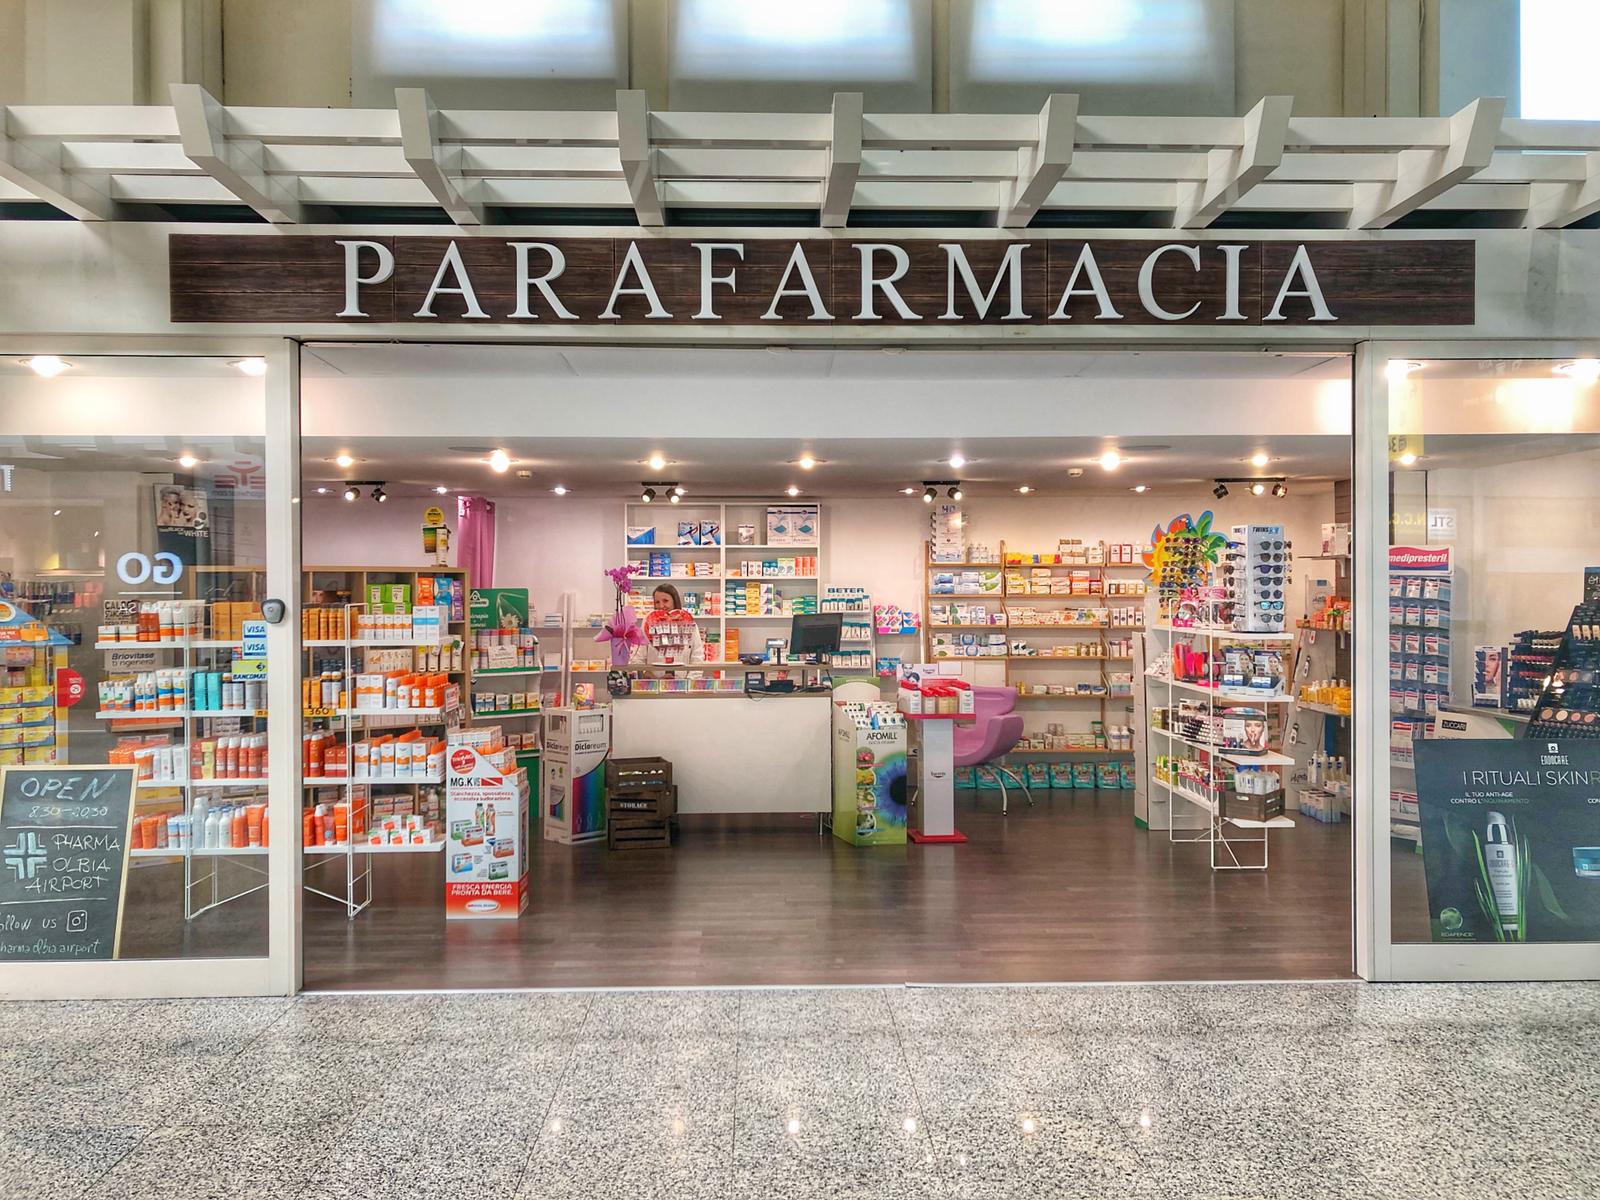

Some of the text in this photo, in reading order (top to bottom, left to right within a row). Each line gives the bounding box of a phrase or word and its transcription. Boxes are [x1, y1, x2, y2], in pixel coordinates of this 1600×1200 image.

[334, 240, 1339, 322] PARAFARMACIA
[184, 530, 209, 538] WHITE
[247, 625, 266, 633] VISA
[247, 643, 266, 651] VISA
[866, 731, 897, 741] AFOMILL
[574, 742, 606, 751] Dicloreum
[1472, 770, 1541, 786] RITUALI
[20, 773, 117, 801] OPEN
[51, 833, 121, 852] PHARMA
[53, 857, 112, 873] OLBIA
[25, 876, 110, 894] AIRPORT
